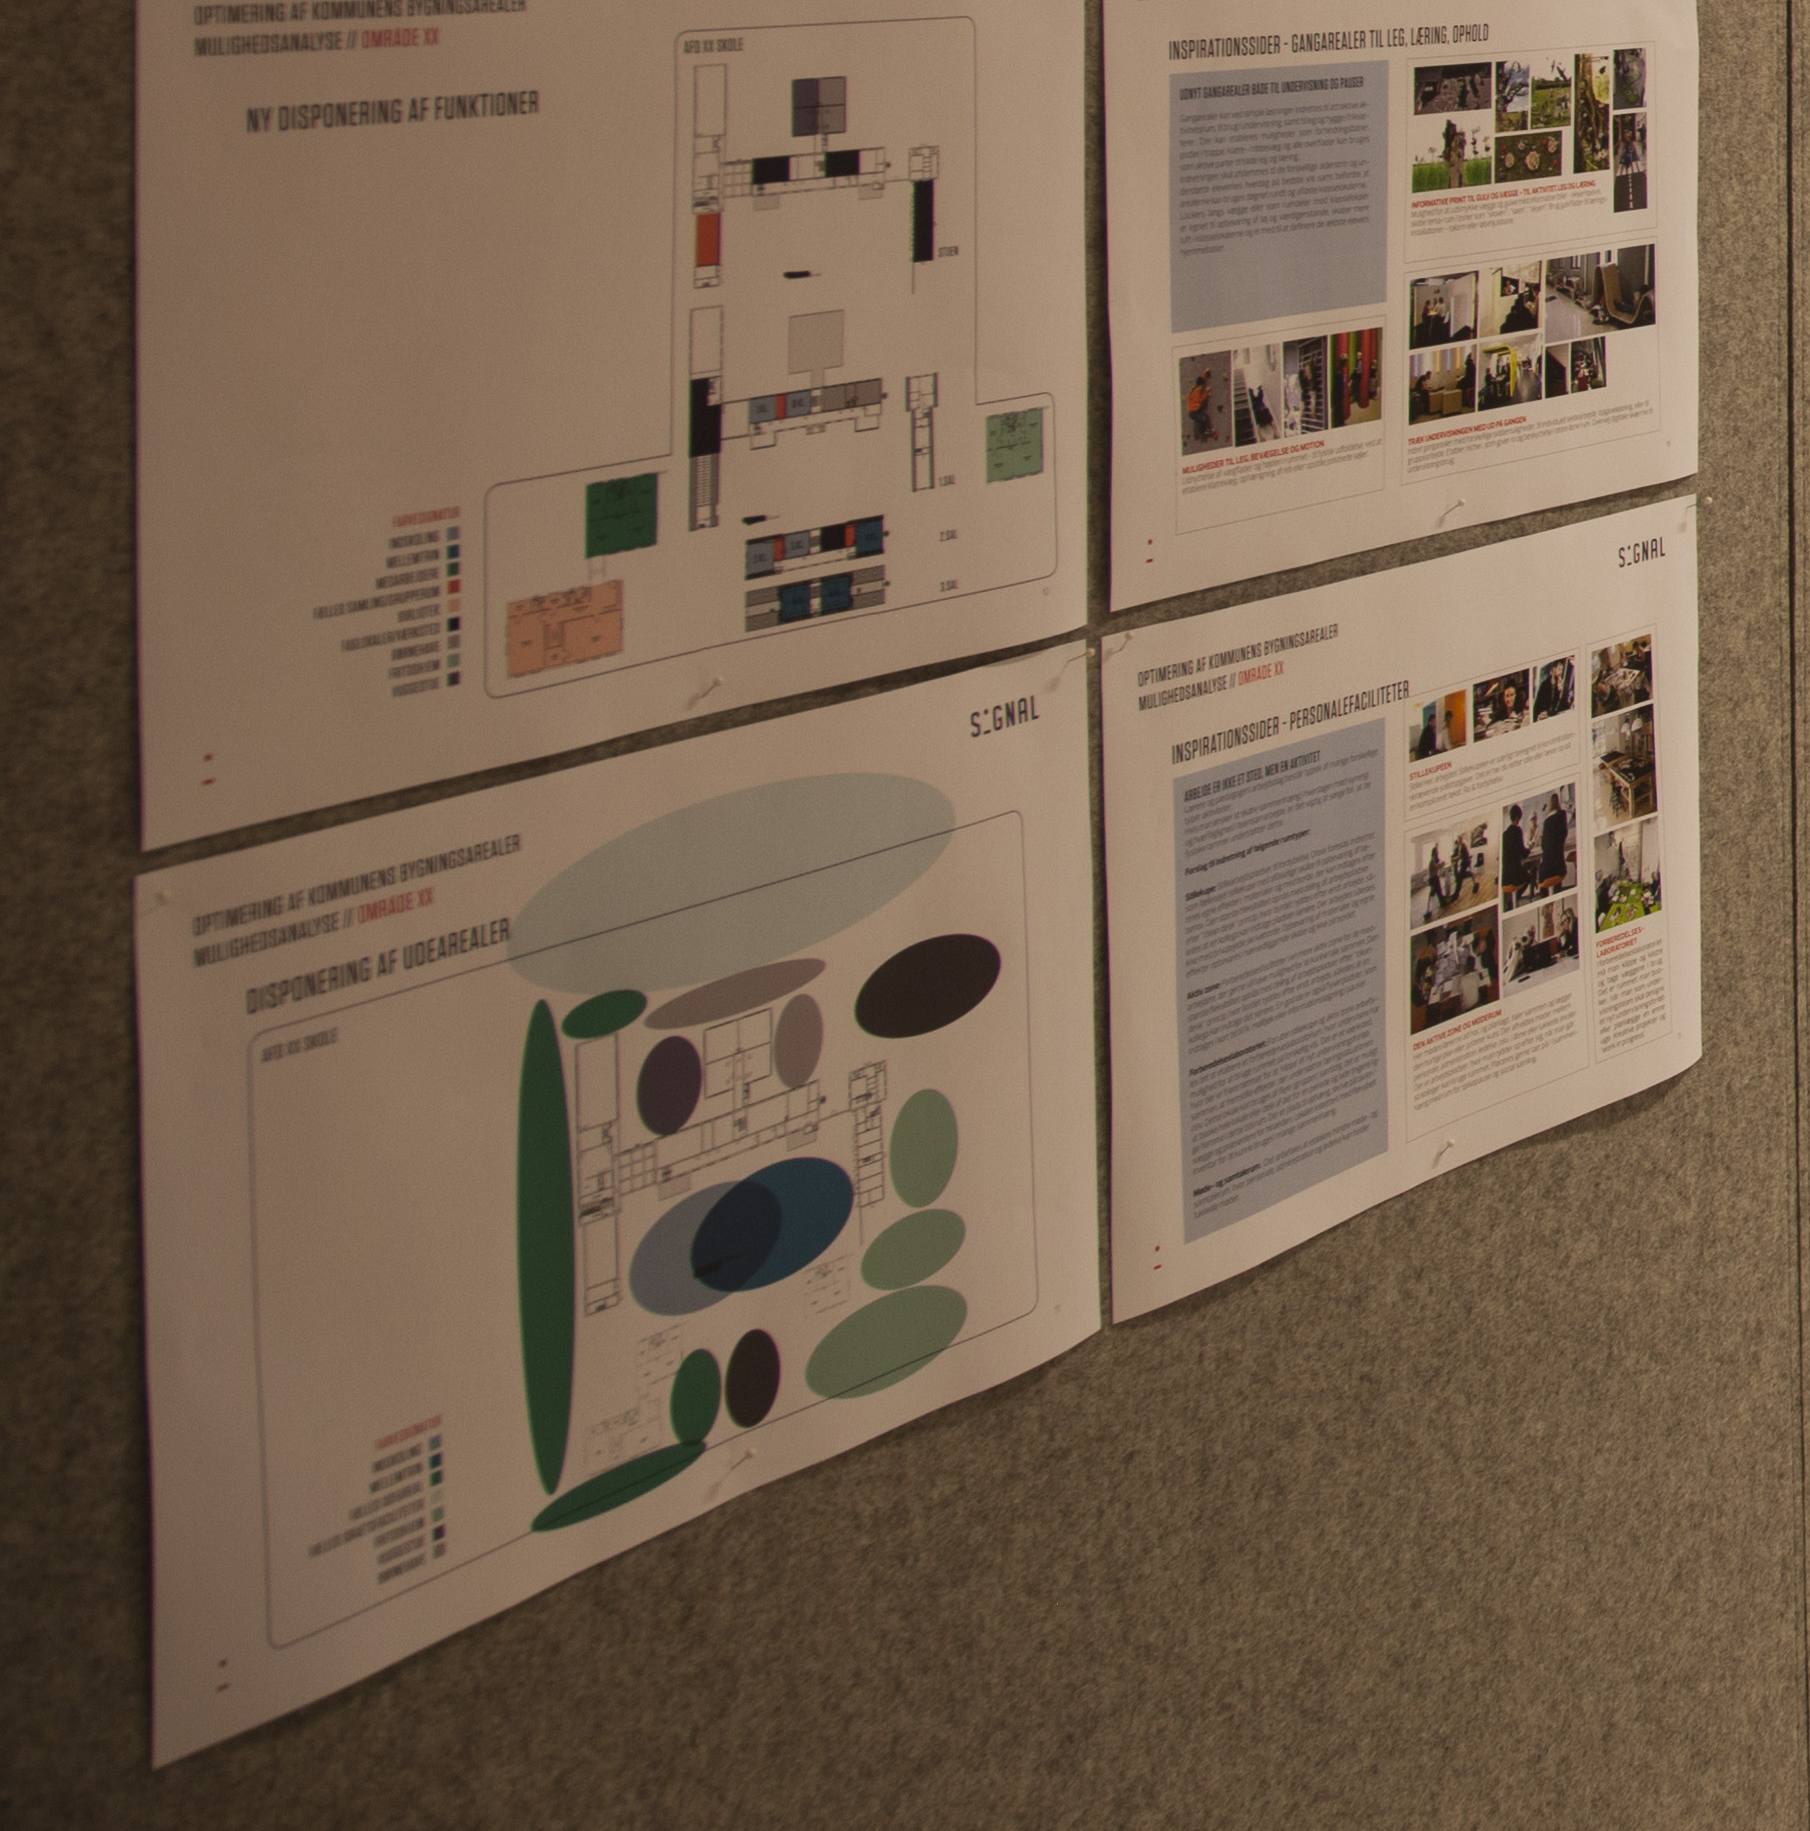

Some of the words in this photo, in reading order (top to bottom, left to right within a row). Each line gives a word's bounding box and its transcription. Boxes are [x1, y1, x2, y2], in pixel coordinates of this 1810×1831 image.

[194, 2, 285, 25] OPTIMERING
[289, 1, 307, 21] AF
[1169, 36, 1280, 60] INSPIRATIONSSIDER
[1290, 31, 1365, 53] GANGAREALER
[1369, 30, 1382, 49] TIL
[1386, 28, 1406, 48] LEG,
[1450, 24, 1488, 44] OPHOLD
[246, 106, 271, 133] NY
[276, 99, 402, 131] DISPONERING
[407, 97, 427, 122] AF
[432, 90, 539, 121] FUNKTIONER
[1138, 659, 1193, 687] OPTIMERING
[1195, 656, 1205, 673] AF
[1207, 642, 1261, 670] KOMMUNENS
[1263, 624, 1338, 656] BYGNINGSAREALER
[1172, 716, 1279, 764] INSPIRATIONSSIDER
[1289, 680, 1410, 732] PERSONALEFACILITETER
[192, 894, 283, 936] OPTIMERING
[287, 889, 303, 912] AF
[306, 866, 395, 907] KOMMUNENS
[399, 834, 520, 883] BYGNINGSAREALER
[246, 956, 371, 1014] DISPONERING
[376, 949, 396, 978] AF
[401, 918, 510, 971] UDEAREALER
